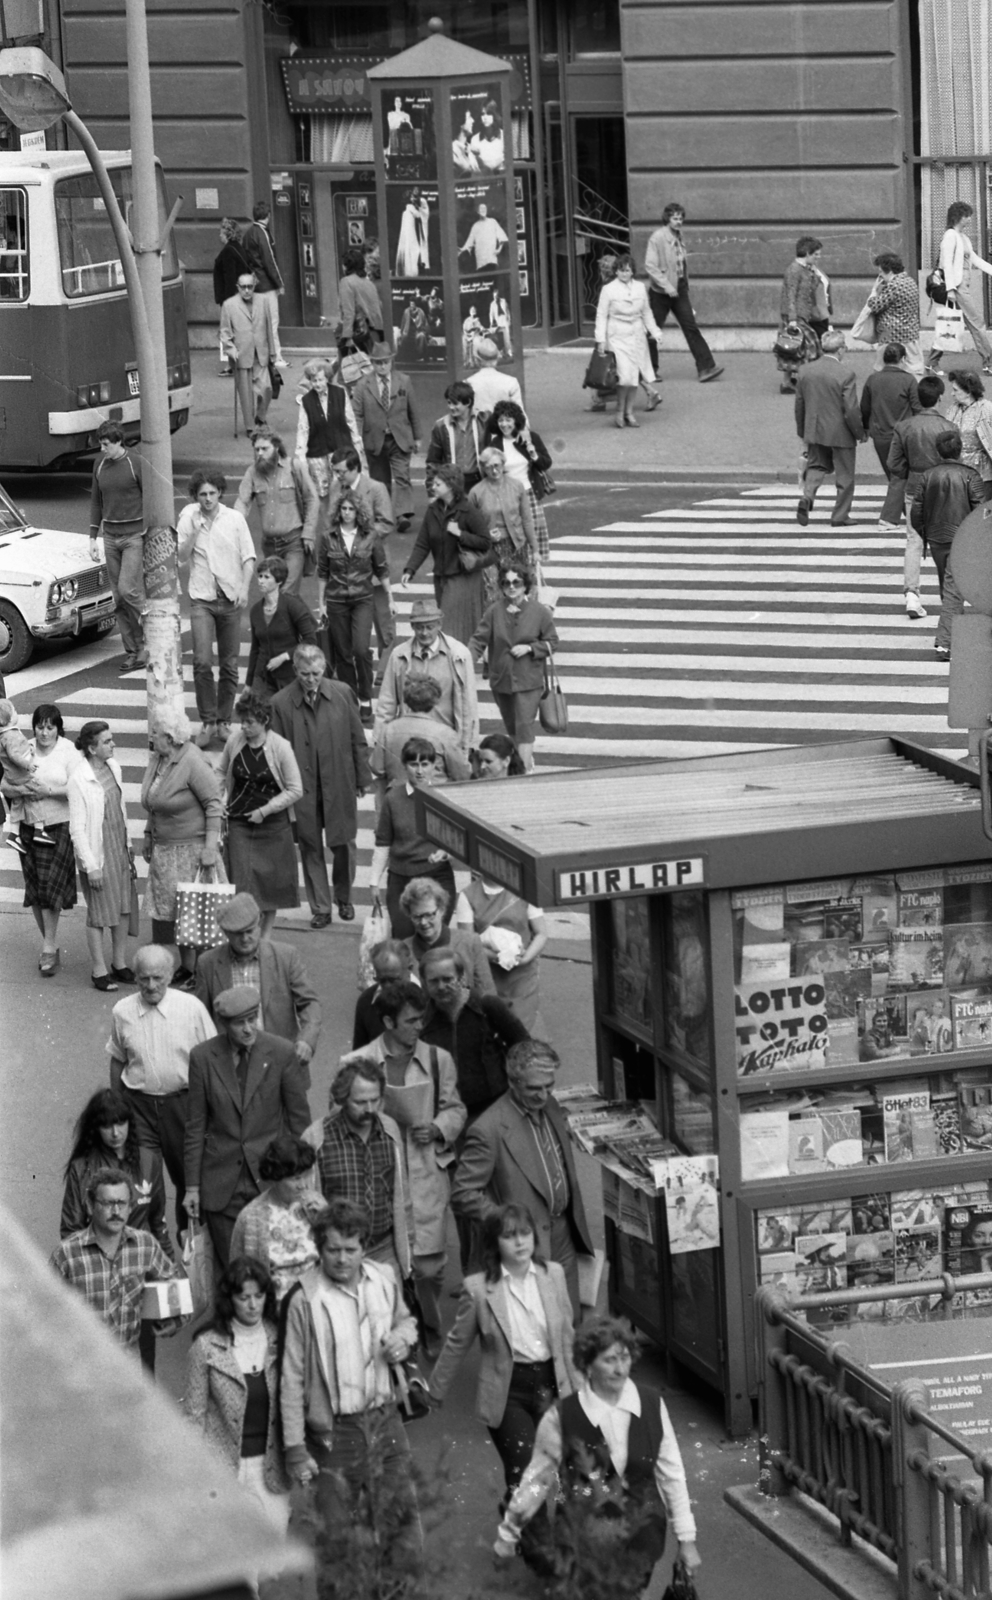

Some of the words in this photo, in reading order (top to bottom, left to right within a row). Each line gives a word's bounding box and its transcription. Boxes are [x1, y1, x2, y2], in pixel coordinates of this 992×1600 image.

[900, 893, 919, 907] FTC
[735, 983, 825, 1017] LOTTO
[954, 1002, 973, 1017] FTC
[735, 1014, 828, 1045] TOTO
[929, 1385, 982, 1398] TEMAFORG
